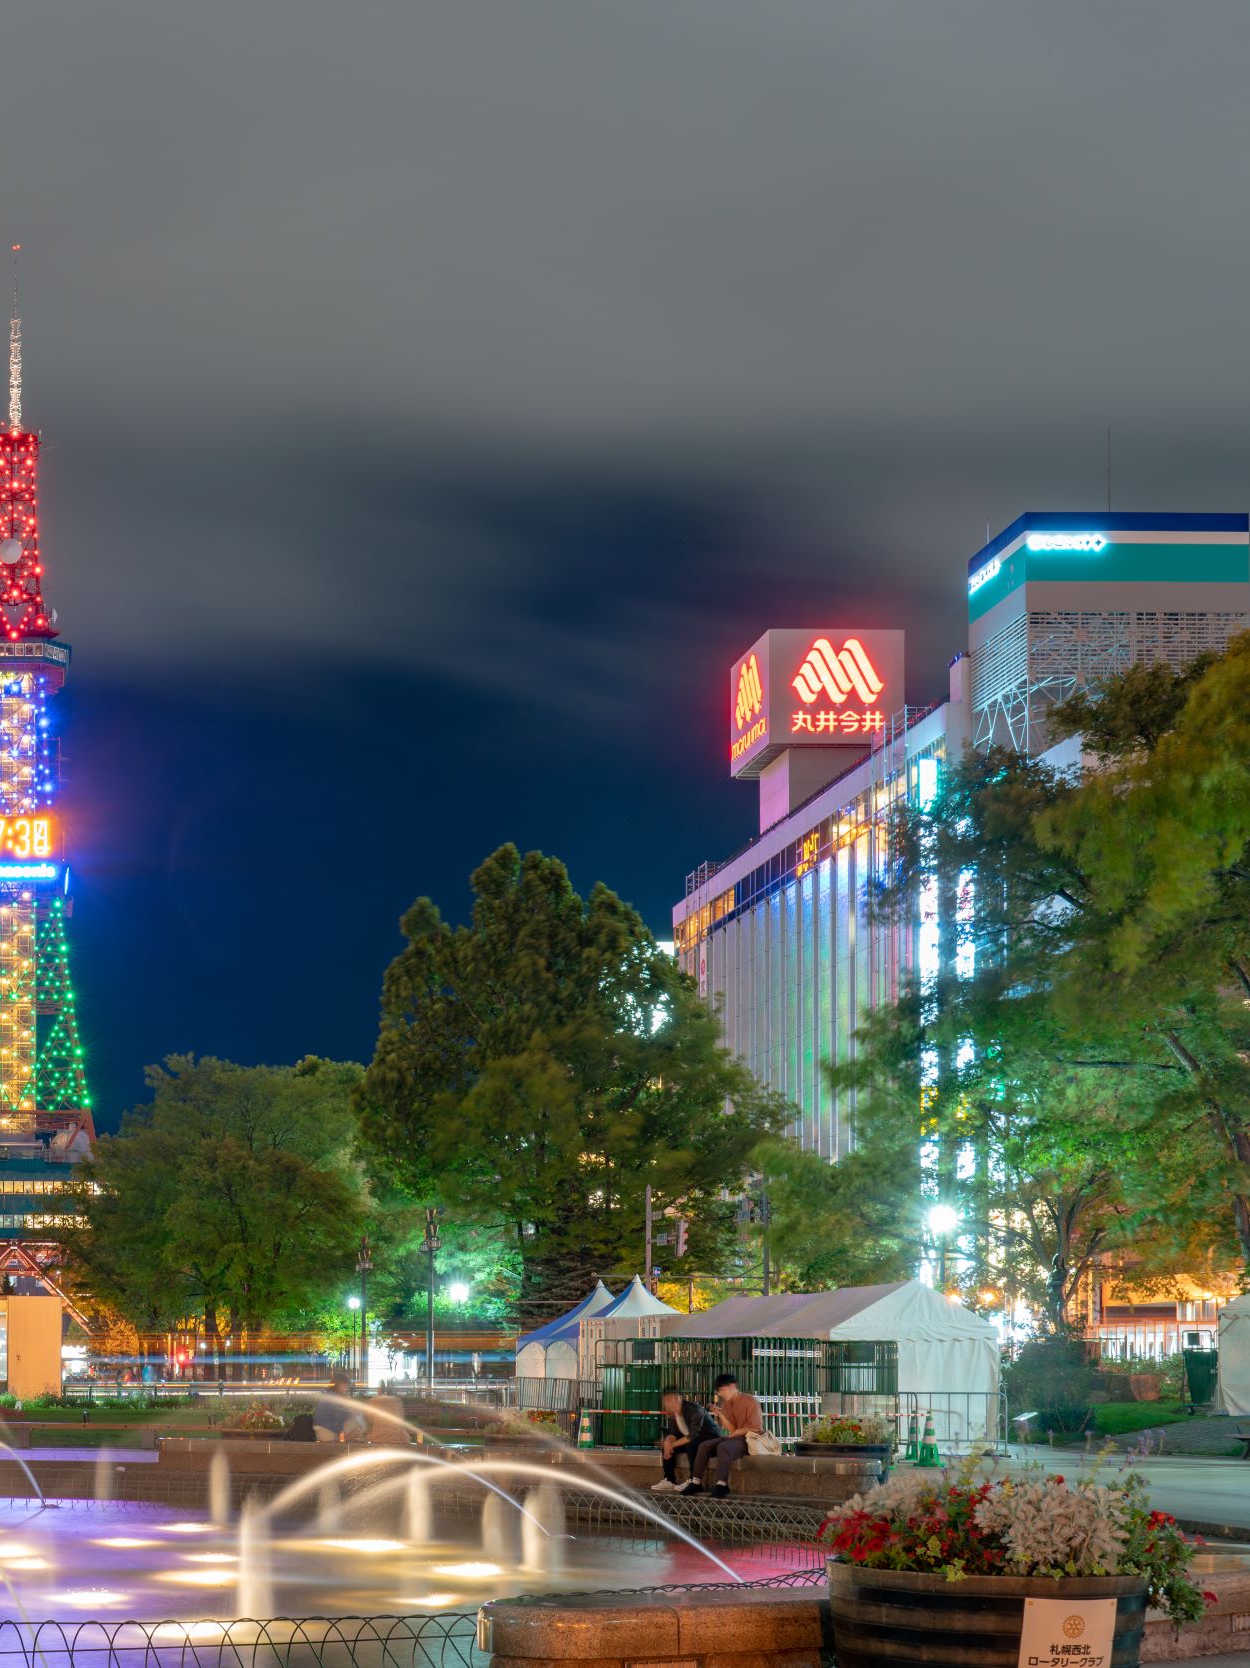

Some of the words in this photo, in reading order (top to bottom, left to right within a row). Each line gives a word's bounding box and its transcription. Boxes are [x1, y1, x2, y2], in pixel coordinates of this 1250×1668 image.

[791, 711, 884, 732] 丸井今井
[1049, 1644, 1091, 1655] 札幌西北
[1028, 1656, 1104, 1667] ロータリークラブ
